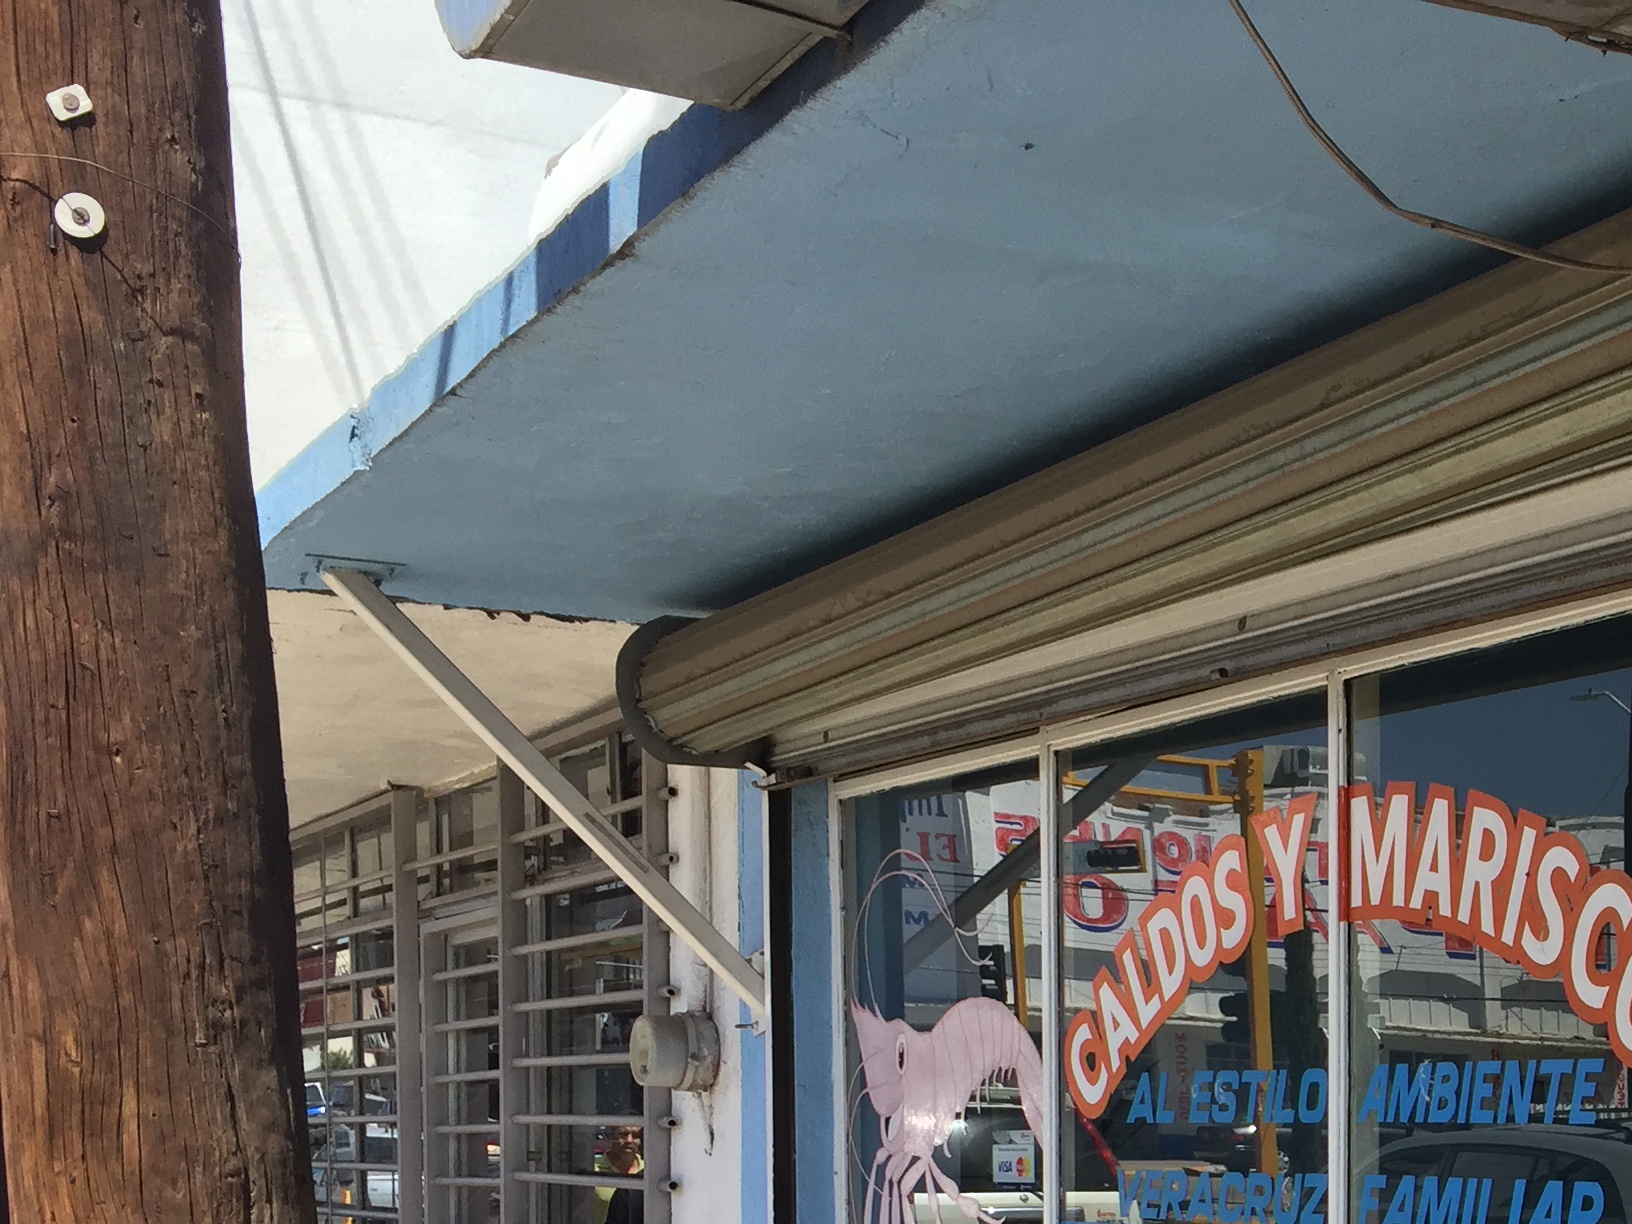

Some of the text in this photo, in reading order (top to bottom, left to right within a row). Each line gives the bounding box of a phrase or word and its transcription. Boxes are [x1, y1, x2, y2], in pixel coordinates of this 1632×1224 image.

[1064, 834, 1254, 1119] CALDOS
[1251, 793, 1317, 936] Y
[1127, 1070, 1182, 1125] AL
[1190, 1069, 1327, 1125] ESTILO
[1359, 1058, 1604, 1125] AMBIENTE
[998, 1160, 1013, 1173] VISA
